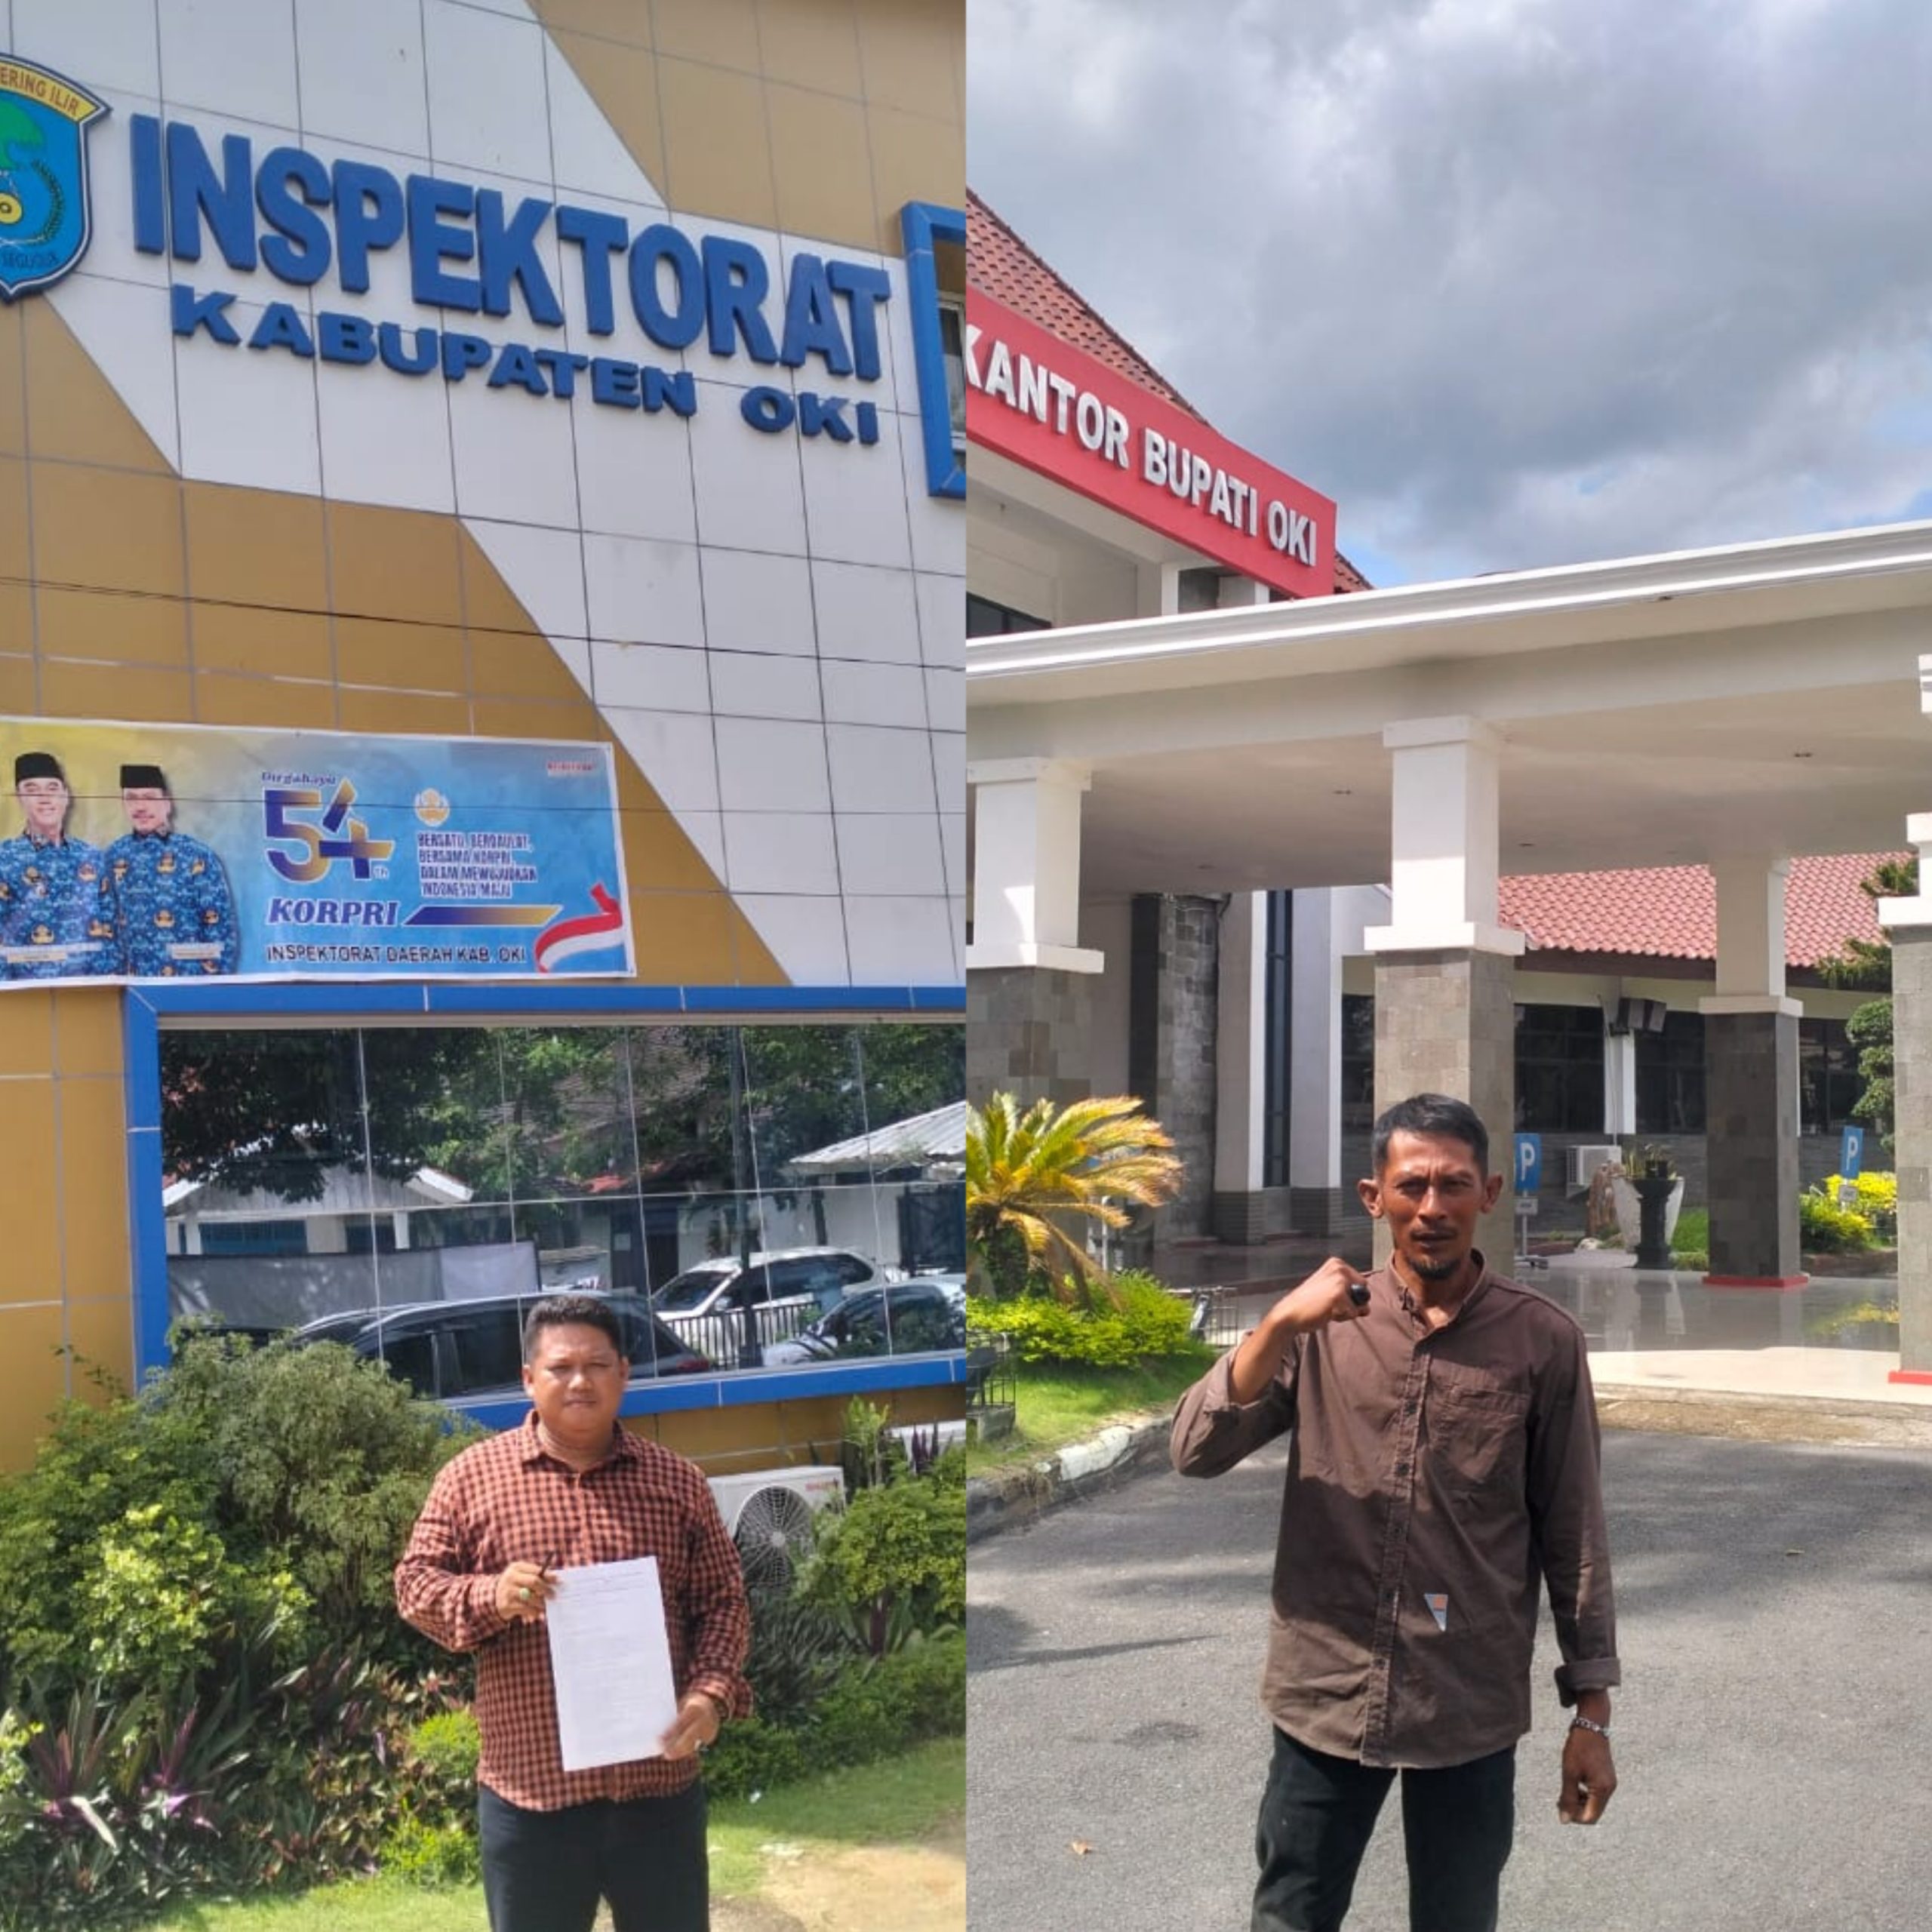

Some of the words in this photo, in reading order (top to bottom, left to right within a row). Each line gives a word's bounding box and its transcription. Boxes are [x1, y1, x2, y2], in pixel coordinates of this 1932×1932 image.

[49, 84, 79, 117] ILIR
[130, 112, 891, 383] INSPEKTORAT
[171, 283, 697, 418] KABUPATEN
[740, 386, 879, 446] OKI
[1143, 427, 1259, 537] BUPATI
[1268, 500, 1318, 568] OKI
[264, 778, 395, 883] 54
[420, 866, 458, 879] DALAM
[479, 882, 512, 897] MAJU
[268, 897, 399, 927] KORPRI
[267, 944, 380, 963] INSPEKTORAT
[386, 945, 453, 963] DAERAH
[1521, 1142, 1535, 1181] P
[1846, 1136, 1858, 1171] P
